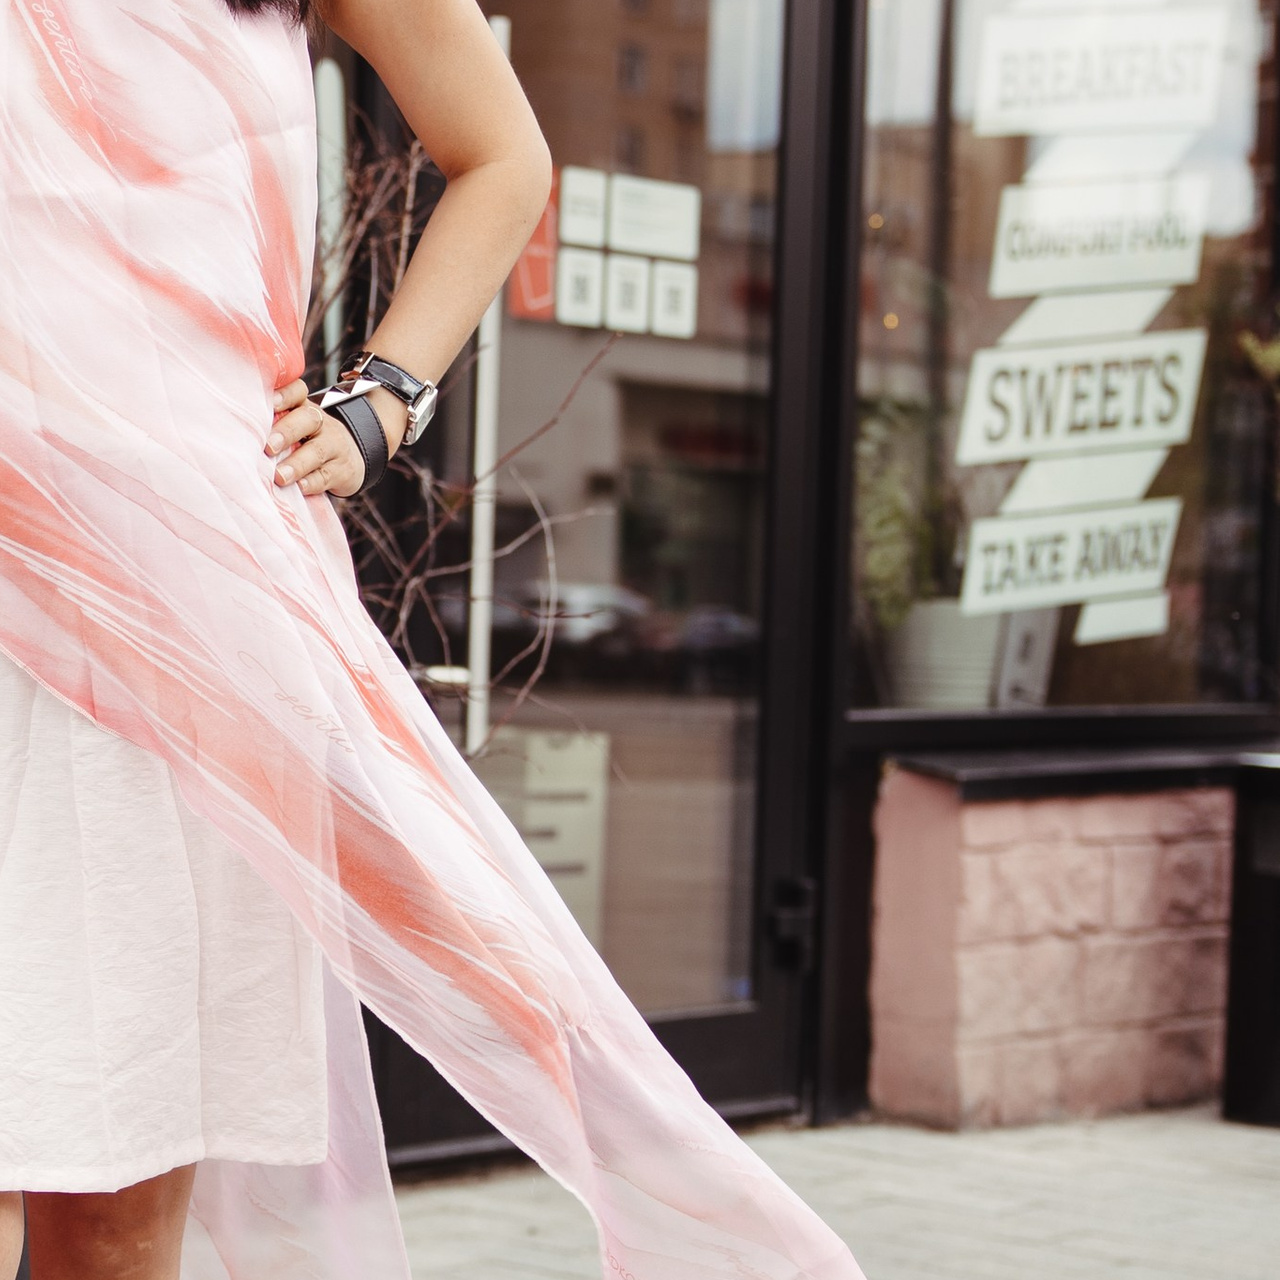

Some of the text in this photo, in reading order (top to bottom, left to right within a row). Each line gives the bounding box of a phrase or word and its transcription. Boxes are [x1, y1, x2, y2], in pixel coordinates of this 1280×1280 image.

[999, 39, 1211, 111] BREAKFAST
[983, 353, 1182, 443] SWEETS
[980, 520, 1169, 595] TAKE AWAY
